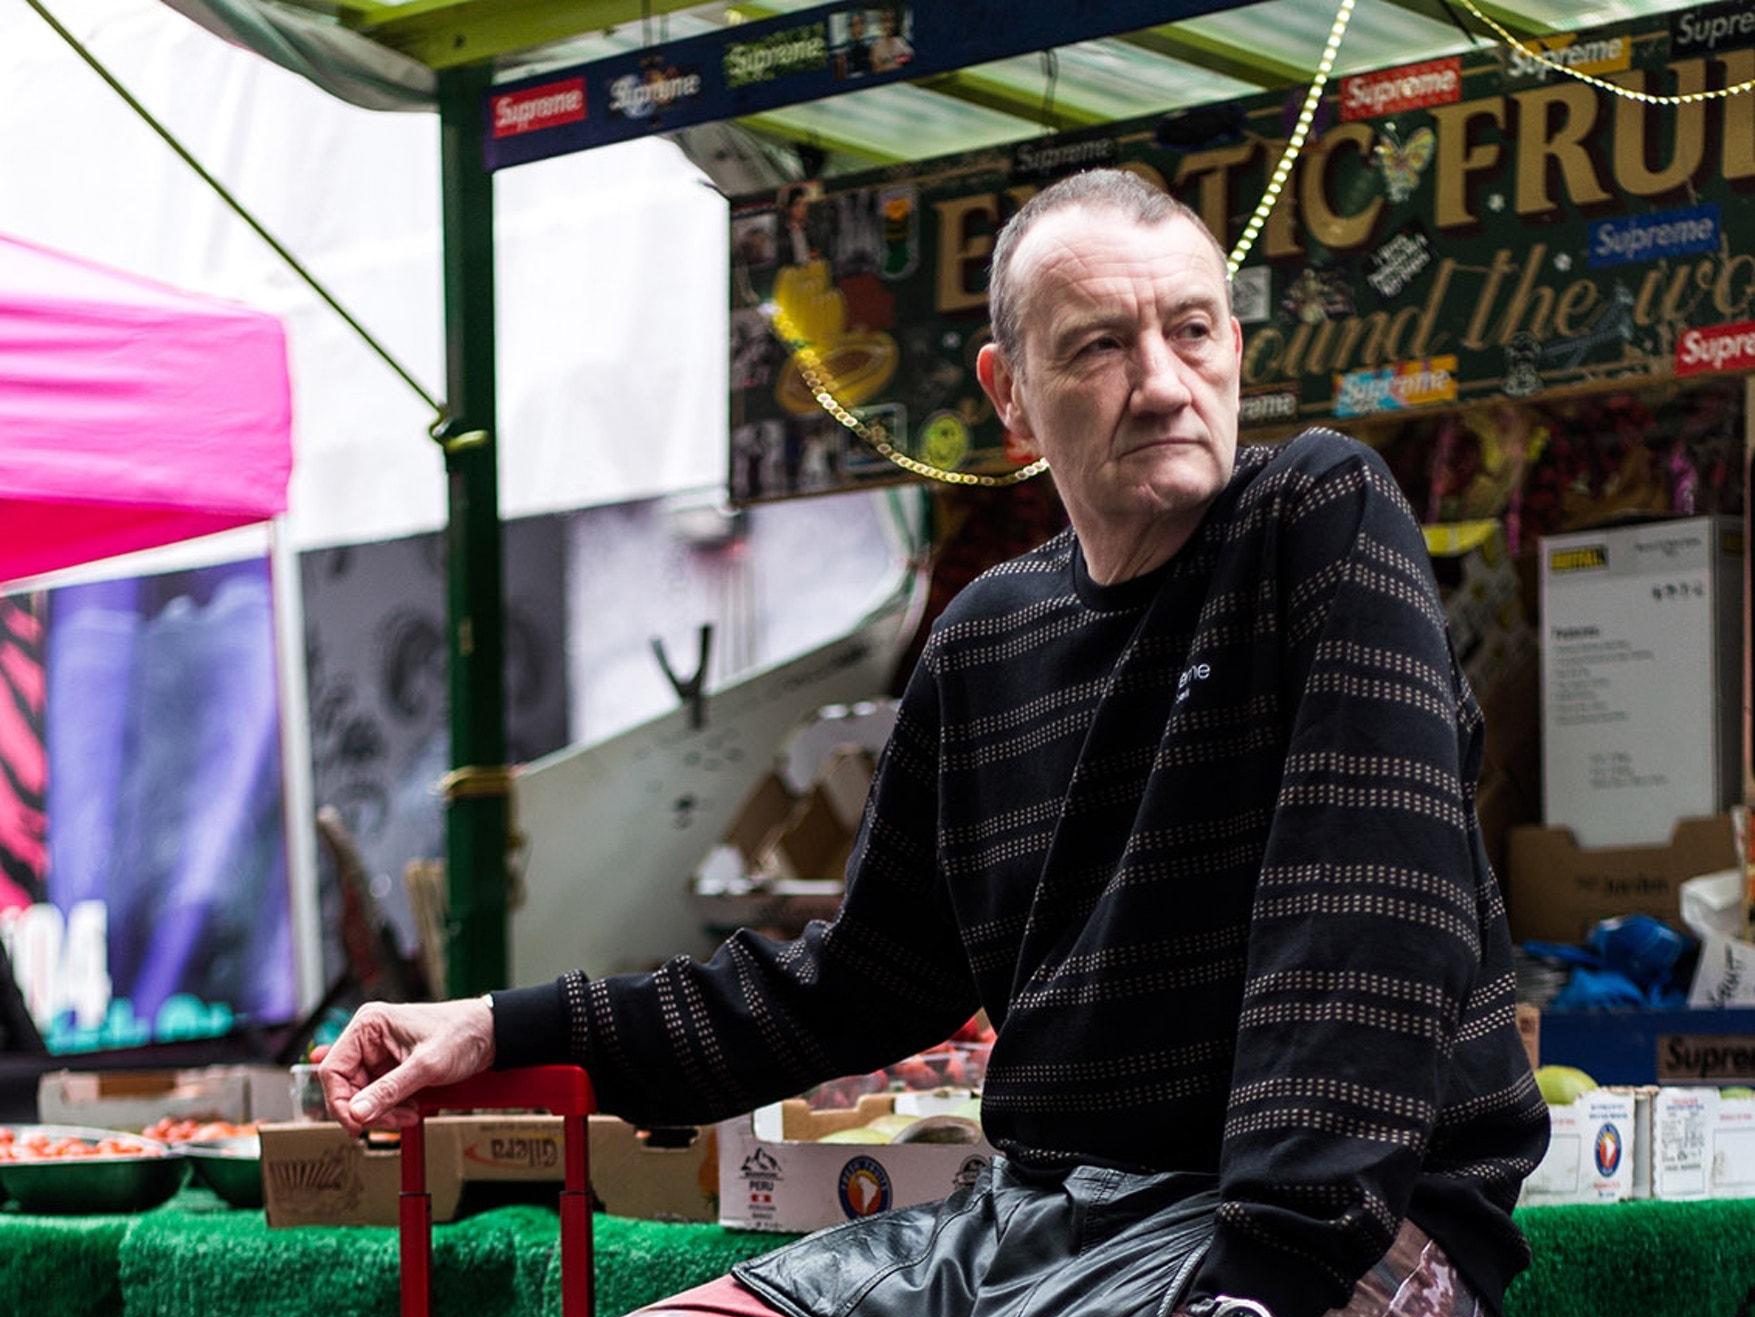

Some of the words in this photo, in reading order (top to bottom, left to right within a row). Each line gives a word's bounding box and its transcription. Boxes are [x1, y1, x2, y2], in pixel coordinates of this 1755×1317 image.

[1508, 35, 1624, 81] Supreme
[496, 89, 584, 132] Supreme
[609, 73, 701, 112] Supreme
[1346, 69, 1458, 112] Supreme
[1015, 138, 1116, 175] Supreme
[1595, 217, 1714, 259] Supreme
[490, 1136, 559, 1168] Gilera
[748, 1179, 775, 1192] PERU
